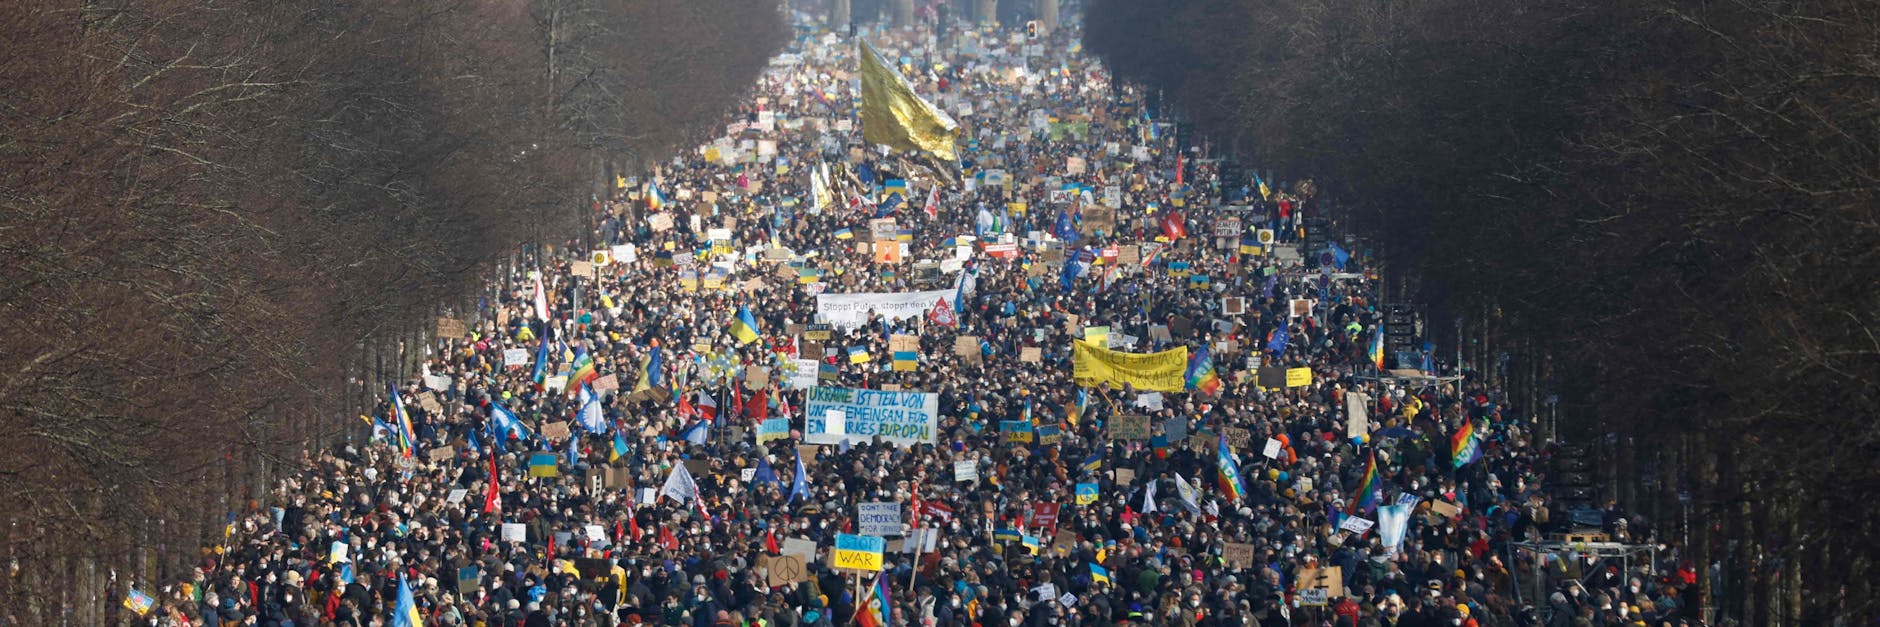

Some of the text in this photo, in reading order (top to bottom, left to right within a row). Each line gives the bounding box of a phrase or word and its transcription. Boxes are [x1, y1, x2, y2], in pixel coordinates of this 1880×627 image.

[823, 302, 851, 312] Stoppt
[881, 301, 908, 311] stoppt
[910, 299, 927, 309] den
[809, 385, 926, 408] UKRAINE IST TEIL VON
[908, 411, 928, 424] FÜR
[879, 423, 929, 440] EUROPA!
[860, 514, 900, 523] DEMOCRACY
[865, 525, 877, 533] FOR
[840, 536, 877, 549] STOP
[839, 551, 873, 566] WAR
